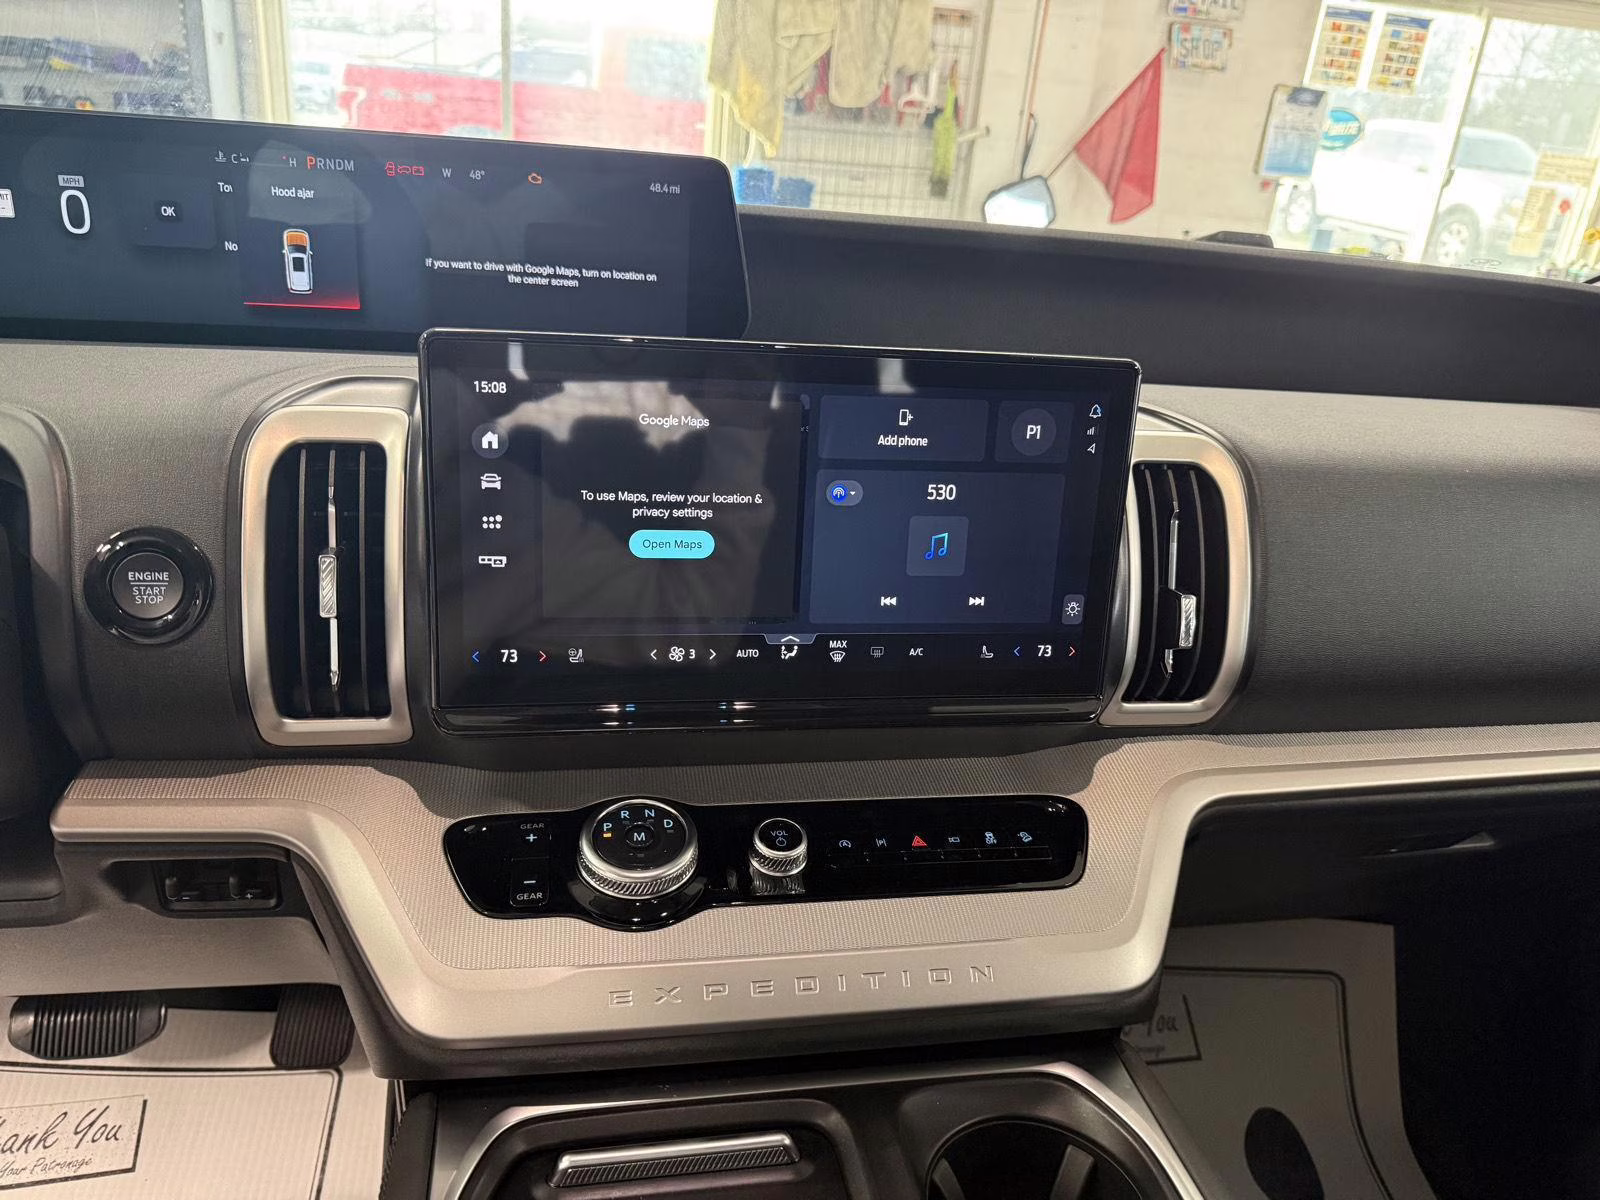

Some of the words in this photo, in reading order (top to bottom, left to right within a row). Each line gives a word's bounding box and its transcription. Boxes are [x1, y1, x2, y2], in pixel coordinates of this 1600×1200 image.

[442, 168, 452, 179] W
[62, 177, 81, 185] MPH
[271, 186, 296, 198] Hood
[297, 188, 315, 199] ajar
[60, 189, 91, 235] 0
[161, 206, 176, 217] OK
[225, 241, 239, 252] No
[425, 257, 433, 267] If
[433, 259, 450, 270] you
[450, 260, 473, 271] want
[473, 261, 483, 271] to
[483, 261, 505, 272] drive
[505, 262, 524, 273] with
[524, 264, 555, 276] Google
[555, 265, 581, 278] Maps,
[582, 268, 600, 279] turn
[600, 269, 612, 280] on
[612, 270, 645, 282] location
[646, 273, 658, 283] on
[507, 274, 522, 284] the
[523, 275, 551, 286] center
[551, 277, 580, 288] screen
[473, 381, 507, 394] 15:08
[639, 413, 679, 428] Google
[680, 415, 710, 429] Maps
[1025, 424, 1041, 440] P1
[877, 435, 899, 447] Add
[898, 437, 928, 449] phone
[580, 490, 594, 501] To
[596, 493, 616, 502] use
[618, 491, 649, 504] Maps,
[651, 492, 685, 503] review
[686, 494, 710, 505] your
[712, 493, 752, 504] location
[754, 494, 763, 504] &
[926, 483, 957, 501] 530
[632, 506, 670, 519] privacy
[672, 508, 714, 520] settings
[642, 539, 671, 549] Open
[674, 540, 703, 552] Maps
[128, 571, 169, 581] ENGINE
[132, 586, 166, 596] START
[135, 595, 164, 605] STOP
[829, 640, 848, 649] MAX
[500, 649, 519, 663] 73
[688, 649, 697, 660] 3
[736, 649, 759, 659] AUTO
[909, 647, 924, 657] A/C
[1037, 645, 1052, 657] 73
[620, 810, 630, 819] R
[644, 808, 656, 818] N
[603, 822, 613, 832] P
[663, 819, 674, 828] D
[633, 832, 646, 842] M
[770, 830, 789, 838] VOL
[516, 892, 543, 901] GEAR
[608, 964, 995, 1009] EXPEDITION
[0, 1111, 68, 1154] ank
[73, 1104, 122, 1150] You
[30, 1156, 94, 1175] Patronage
